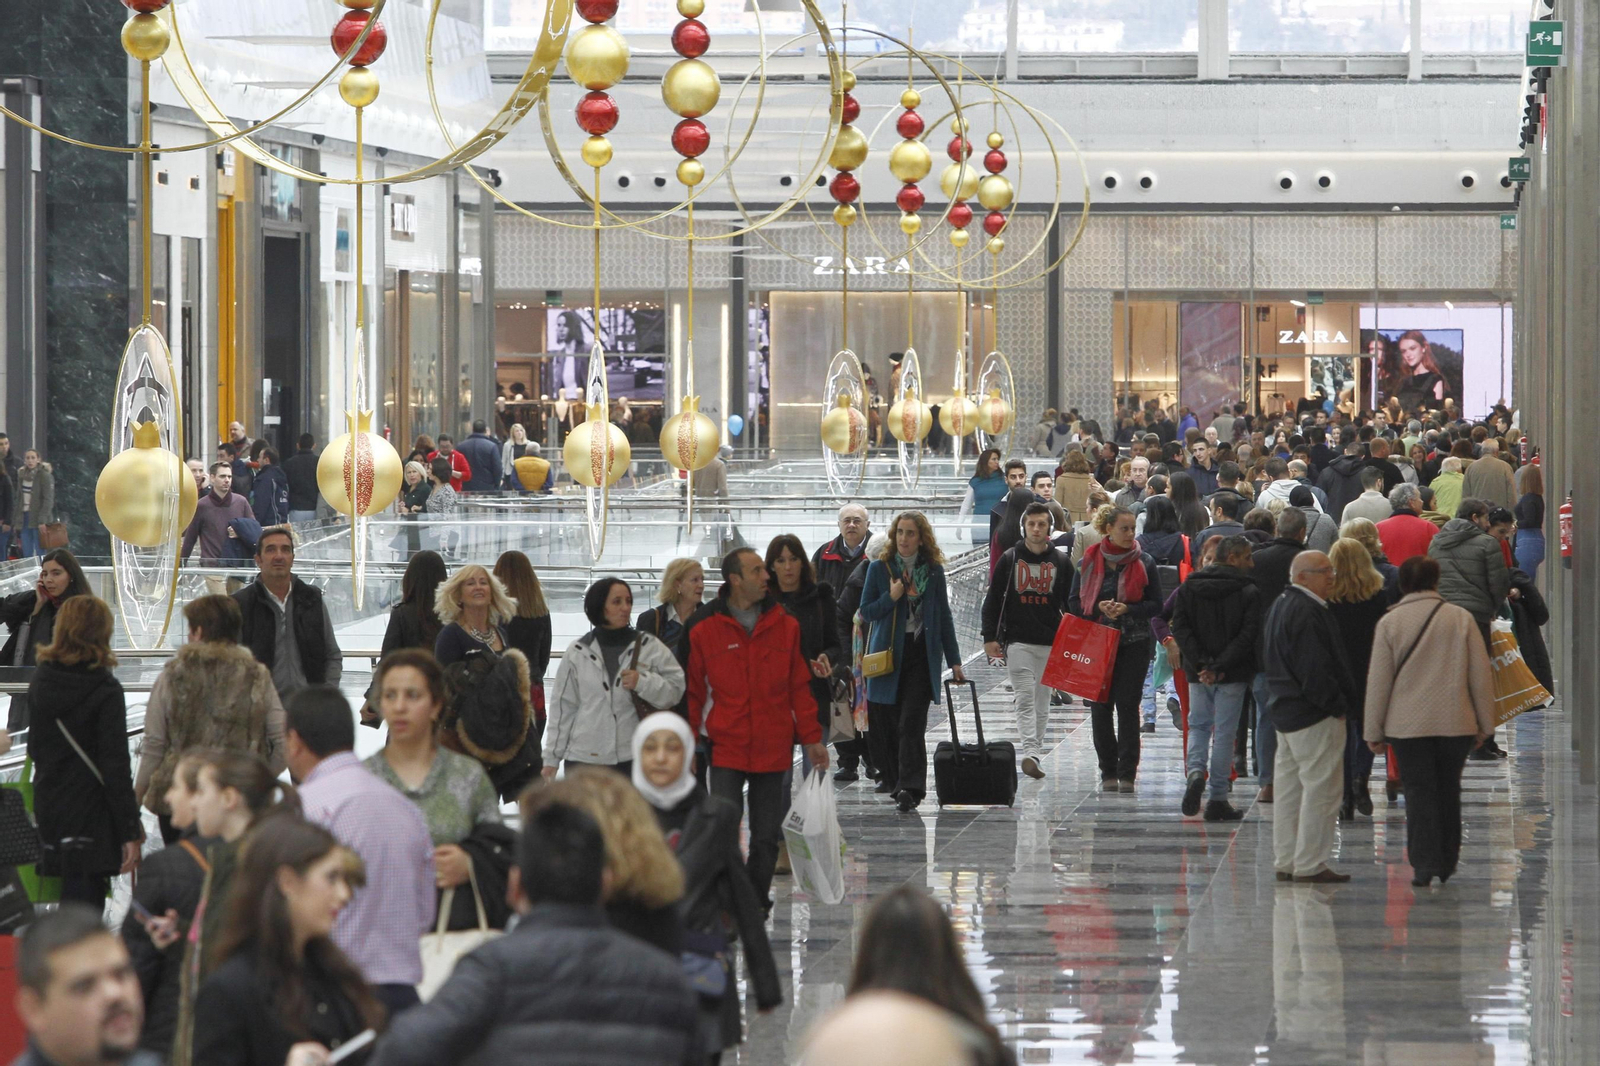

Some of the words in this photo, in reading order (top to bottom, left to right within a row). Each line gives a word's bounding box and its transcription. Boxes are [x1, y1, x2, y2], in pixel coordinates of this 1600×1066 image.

[813, 256, 912, 275] ZARA
[1279, 330, 1349, 344] ZARA
[1017, 559, 1055, 594] Duff
[1020, 596, 1049, 605] BEER
[1063, 650, 1091, 665] celio
